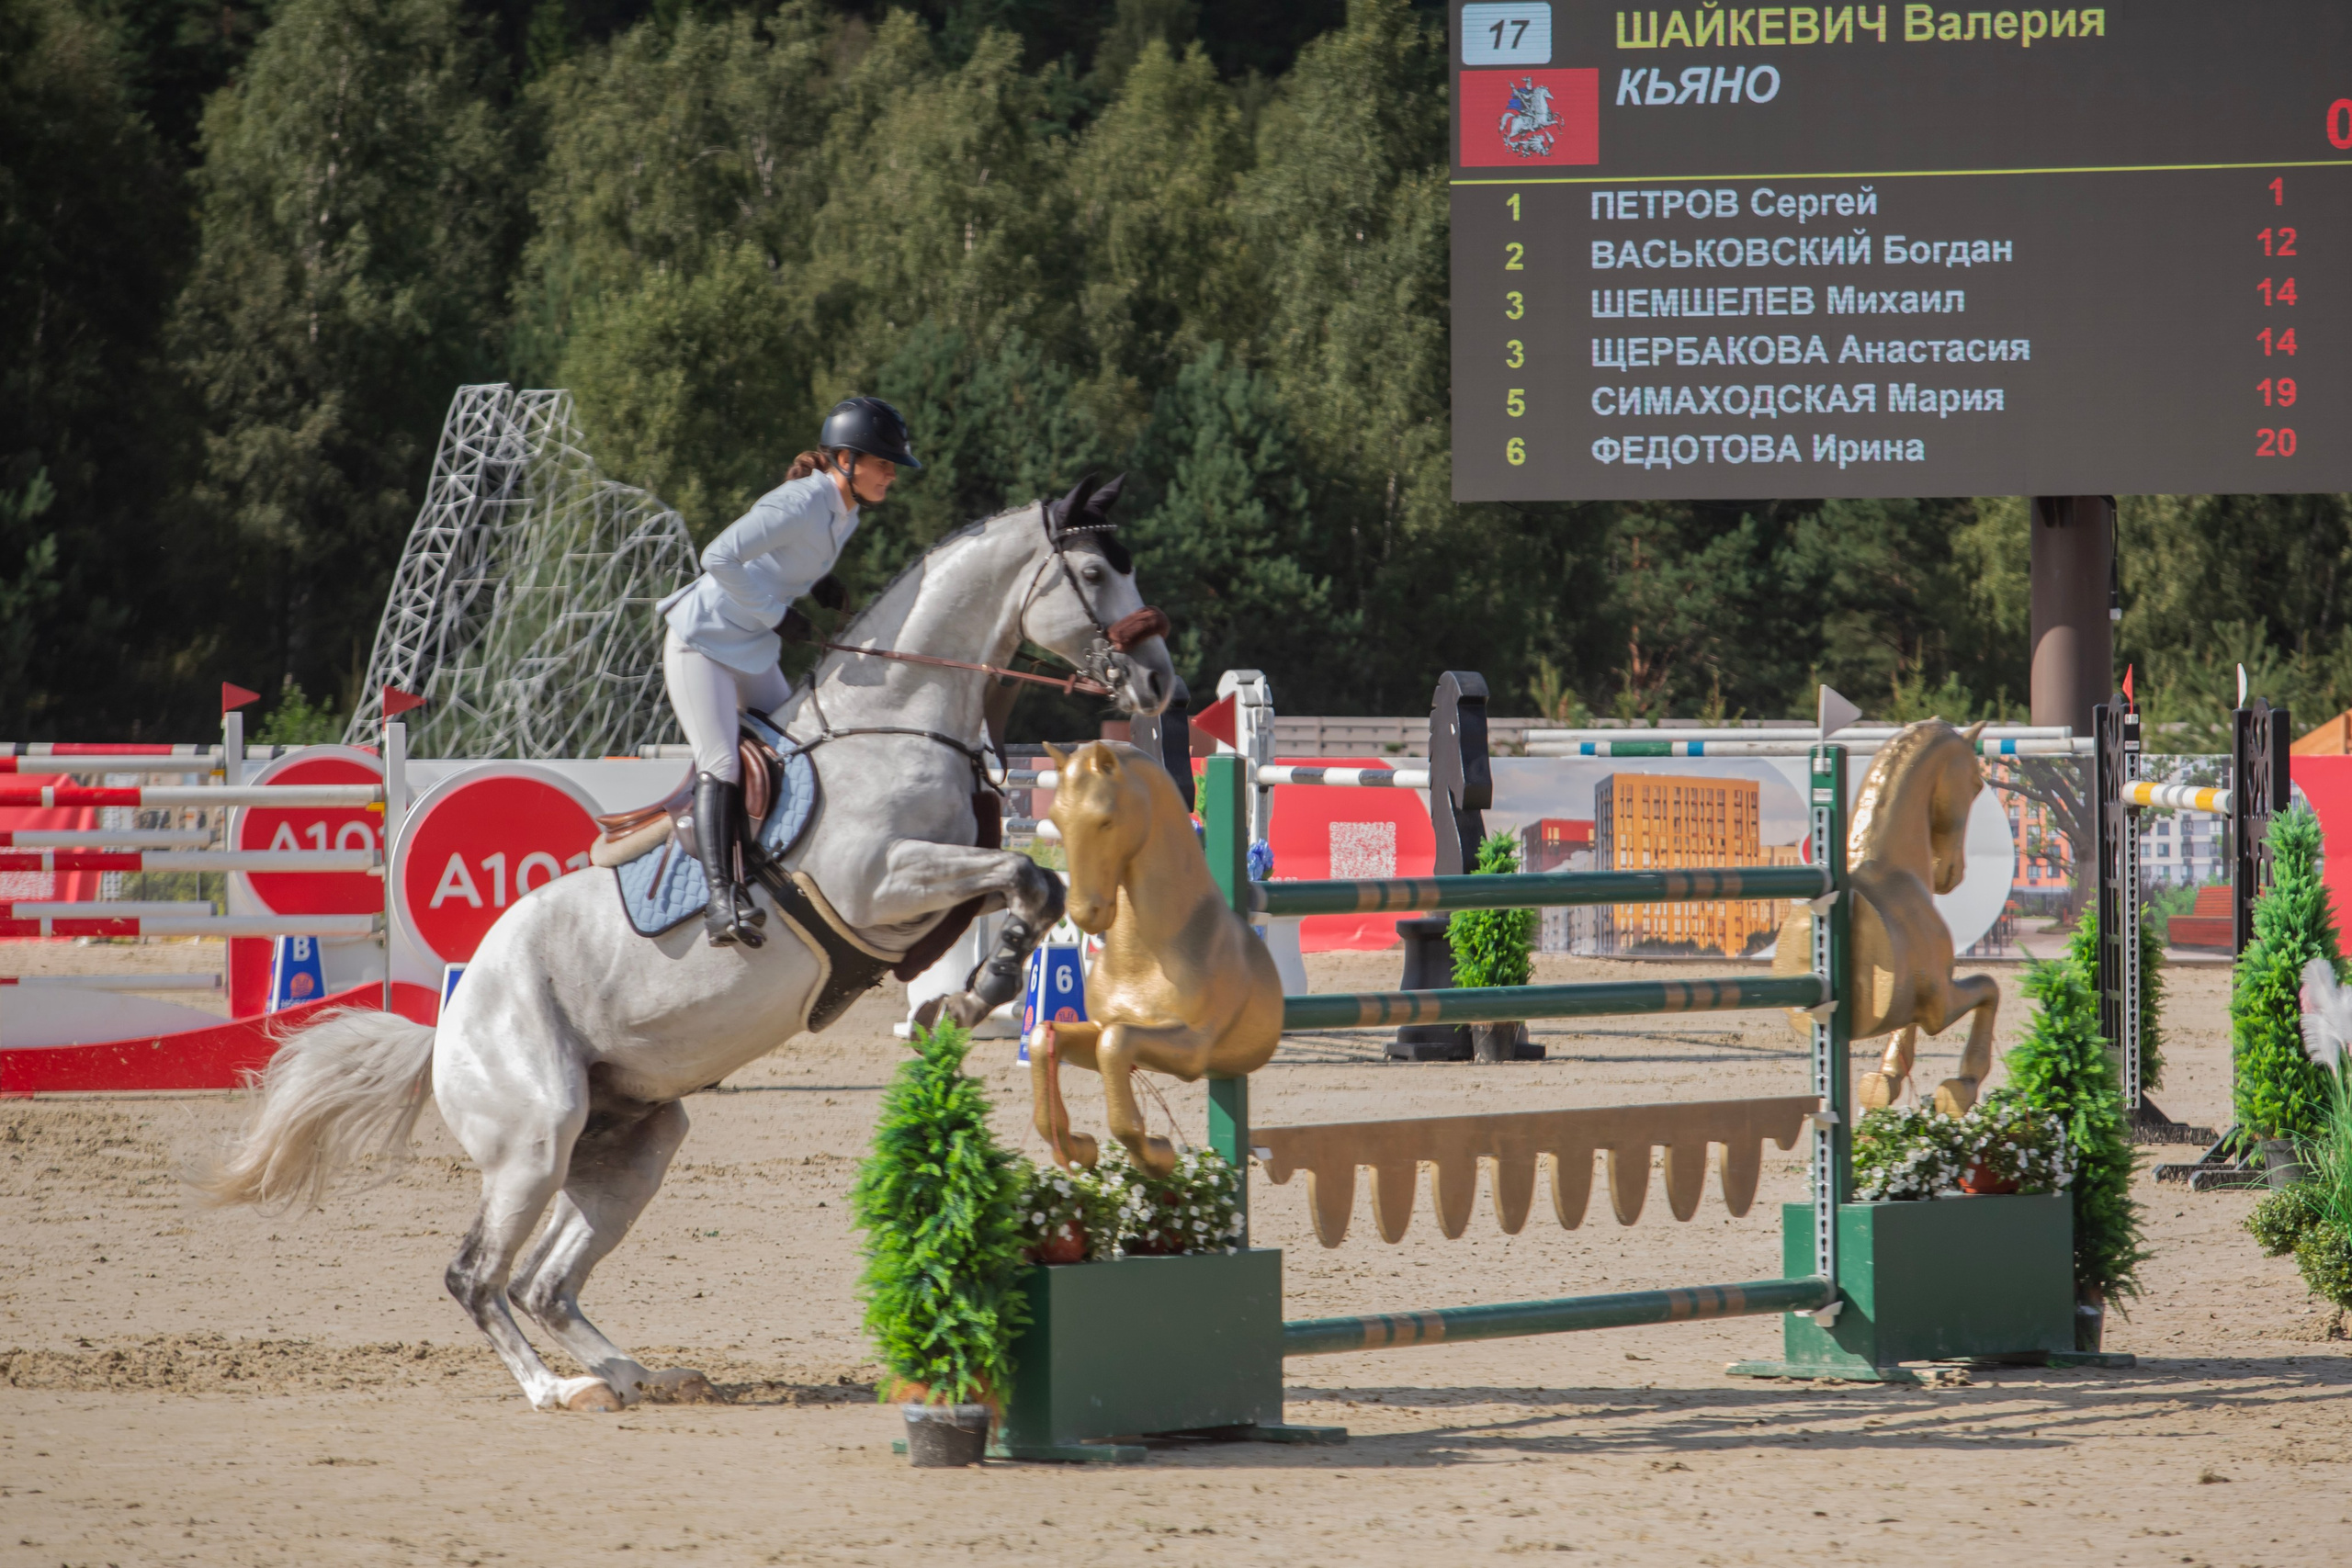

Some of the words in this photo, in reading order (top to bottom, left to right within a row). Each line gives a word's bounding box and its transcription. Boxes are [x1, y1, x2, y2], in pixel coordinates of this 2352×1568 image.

[1489, 20, 1530, 50] 17
[1616, 2, 1886, 49] ШАЙКЕВИЧ
[1905, 5, 2105, 48] Валерия
[1616, 64, 1781, 106] КЬЯНО
[1506, 194, 1521, 220] 1
[1591, 191, 1739, 220] ПЕТРОВ
[1750, 186, 1877, 224] Сергей
[2268, 178, 2283, 206] 1
[1506, 243, 1524, 270] 2
[1591, 230, 1871, 269] ВАСЬКОВСКИЙ
[1883, 235, 2013, 268] Богдан
[2256, 228, 2297, 256] 12
[1506, 292, 1524, 320] 3
[1591, 287, 1815, 318] ШЕМШЕЛЕВ
[1826, 286, 1965, 315] Михаил
[2256, 277, 2298, 306] 14
[1506, 340, 1524, 368] 3
[1591, 335, 1830, 372] ЩЕРБАКОВА
[1838, 334, 2030, 364] Анастасия
[2256, 328, 2298, 356] 14
[1507, 389, 1526, 417] 5
[1591, 384, 1876, 420] СИМАХОДСКАЯ
[1888, 383, 2005, 418] Мария
[2256, 378, 2297, 406] 19
[1507, 437, 1526, 466] 6
[1591, 435, 1803, 470] ФЕДОТОВА
[1812, 434, 1925, 469] Ирина
[2256, 428, 2297, 457] 20
[269, 820, 384, 851] A10
[293, 935, 311, 962] B
[1031, 964, 1038, 993] 6
[1056, 965, 1073, 994] 6
